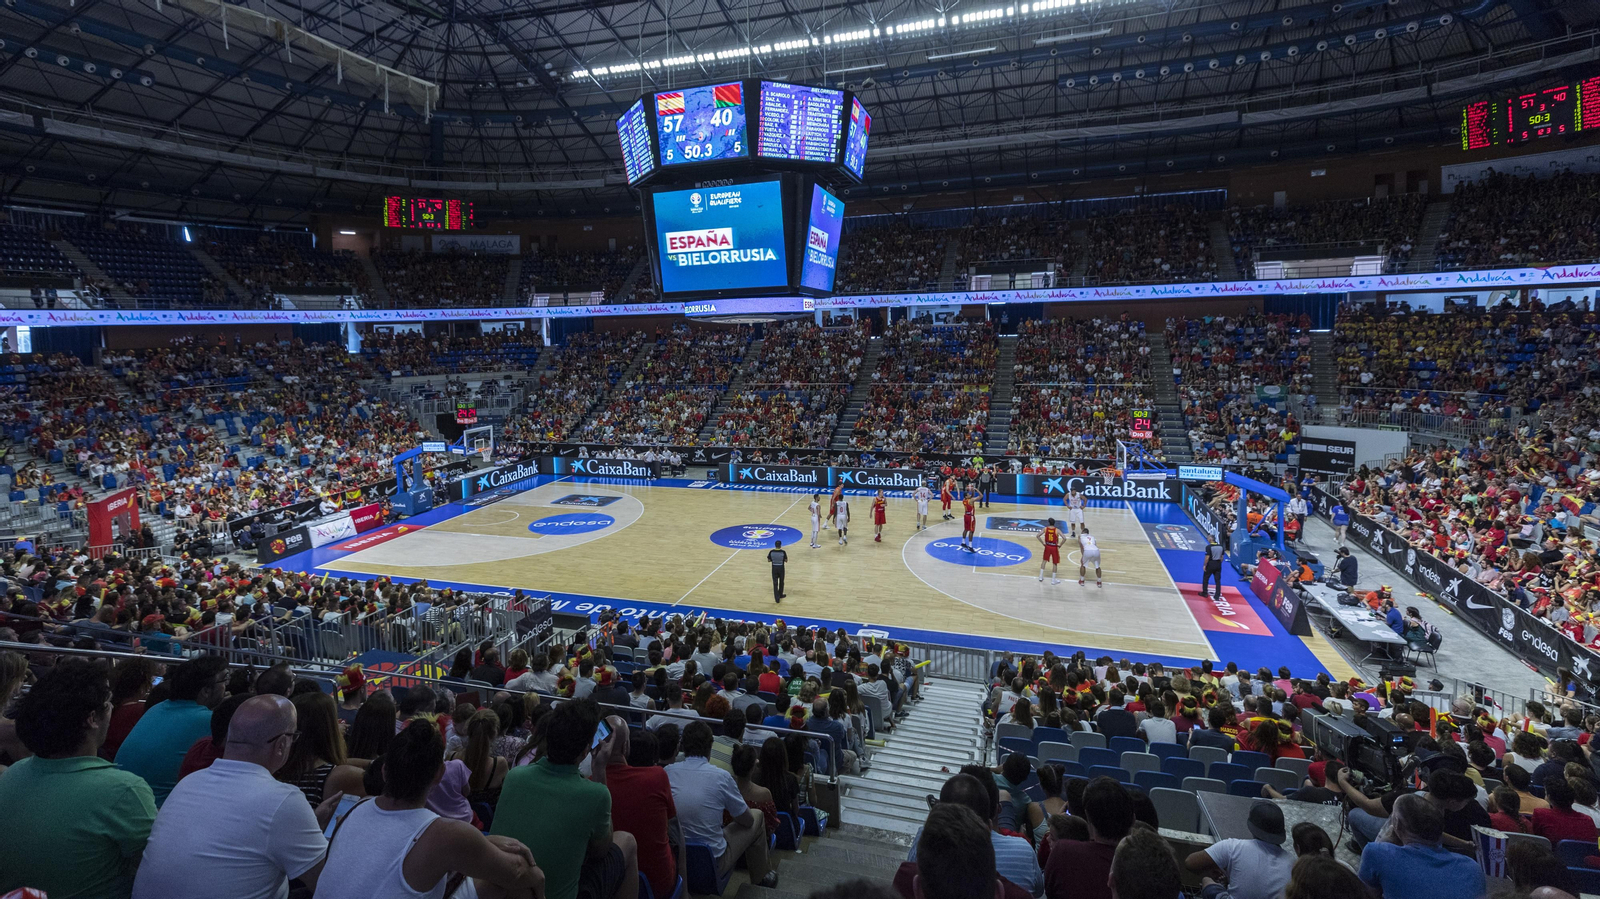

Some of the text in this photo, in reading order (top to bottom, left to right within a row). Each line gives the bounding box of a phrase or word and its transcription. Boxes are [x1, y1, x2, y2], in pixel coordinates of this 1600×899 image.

[1522, 92, 1567, 109] 57 40
[663, 109, 732, 132] 57 40
[1529, 113, 1550, 125] 50:3
[850, 122, 857, 138] 57
[667, 142, 740, 160] 5 50.3 5
[710, 191, 740, 200] EUROPEAN
[710, 198, 742, 206] QUALIFIERS
[670, 230, 730, 250] ESPAÑA
[810, 231, 827, 249] ESPAÑA
[679, 248, 776, 266] BIELORRUSIA
[810, 249, 834, 269] BIELORRUSIA
[1378, 276, 1432, 287] Andalucía
[1456, 271, 1516, 283] Andalucía
[1093, 288, 1133, 297] Andalucía
[1150, 286, 1192, 295] Andalucía
[1210, 283, 1255, 293] Andalucía
[916, 295, 949, 303] Andalucía
[964, 293, 1000, 301] Andalucía
[47, 312, 96, 322] Andalucía
[116, 312, 160, 321] Andalucía
[177, 312, 216, 321] Andalucía
[458, 409, 467, 417] 24
[1135, 418, 1150, 429] 24
[1328, 446, 1354, 454] SEUR
[490, 461, 539, 488] CaixaBank
[754, 467, 817, 483] CaixaBank
[1067, 478, 1171, 500] CaixaBank
[108, 498, 127, 511] IBERIA
[355, 515, 373, 524] IBERIA
[533, 516, 610, 528] endesa
[1352, 522, 1369, 537] endesa
[1256, 571, 1268, 585] IBERIA
[1419, 565, 1440, 585] endesa
[521, 616, 553, 641] endesa
[1522, 630, 1558, 662] endesa
